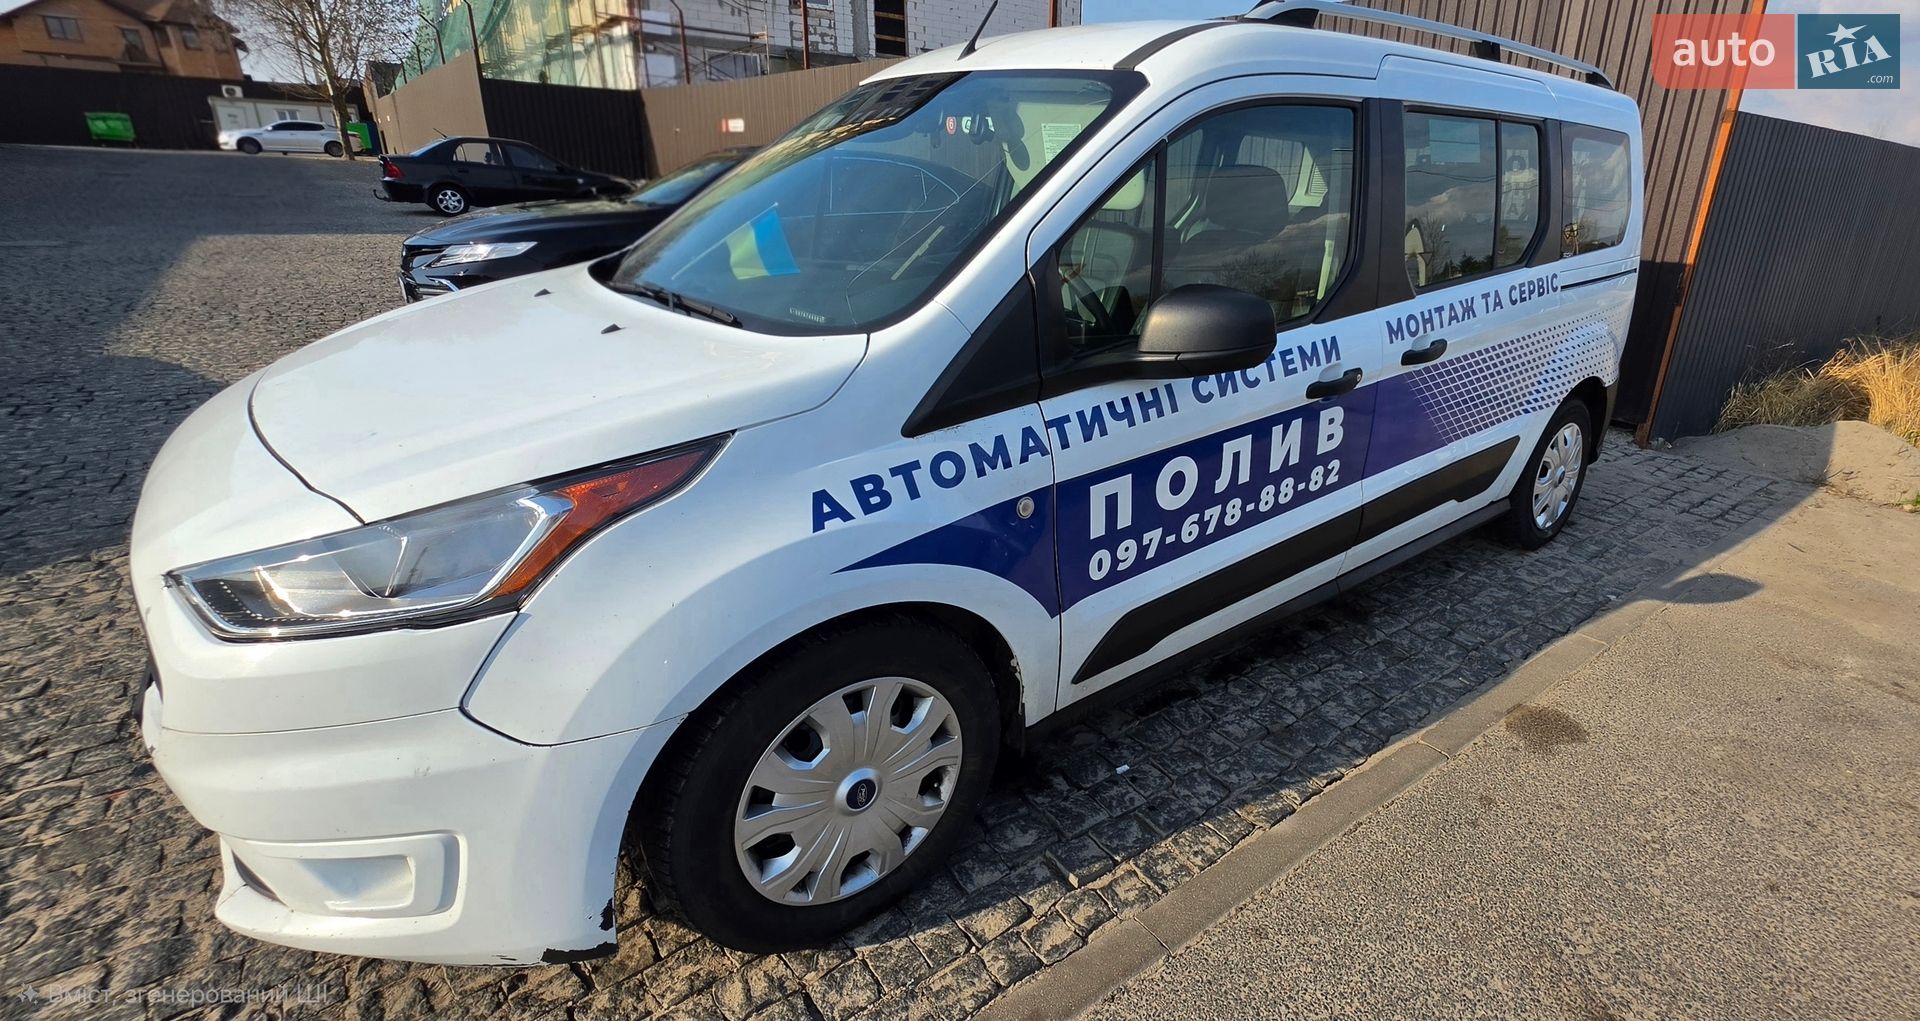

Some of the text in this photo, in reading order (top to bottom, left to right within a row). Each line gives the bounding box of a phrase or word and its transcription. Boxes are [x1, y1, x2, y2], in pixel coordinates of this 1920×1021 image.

[1385, 273, 1559, 345] МОНТАЖ ТА СЕРВІС
[811, 335, 1342, 533] АВТОМАТИЧНІ СИСТЕМИ
[1089, 406, 1345, 540] ПОЛИВ
[1088, 459, 1342, 581] 097-678-88-82
